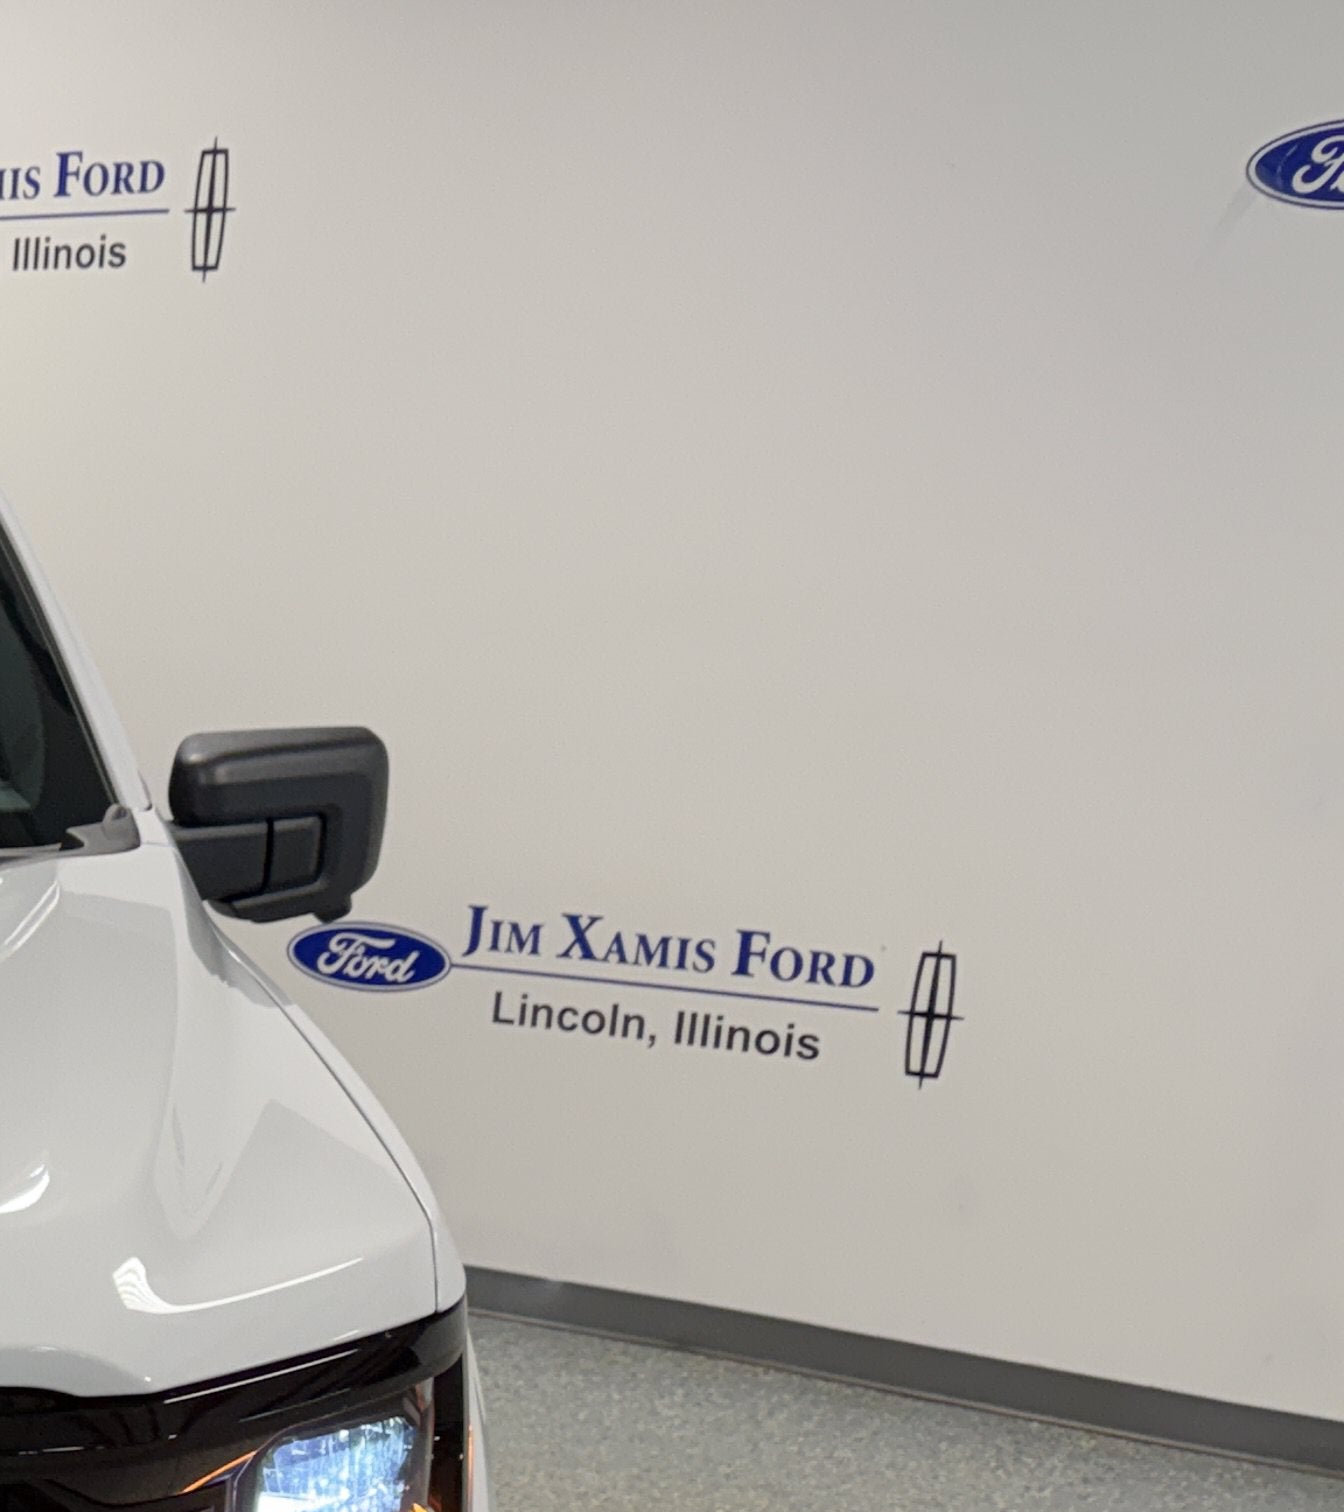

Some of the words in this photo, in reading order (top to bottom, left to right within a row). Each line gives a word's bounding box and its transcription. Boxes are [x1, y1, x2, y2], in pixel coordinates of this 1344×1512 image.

[53, 151, 166, 197] FORD
[11, 234, 127, 271] Illinois
[317, 933, 416, 983] Ford
[462, 905, 545, 957] JIM
[556, 914, 716, 973] XAMIS
[731, 929, 876, 989] FORD
[492, 992, 658, 1049] Lincoln,
[673, 1010, 822, 1060] Illinois
